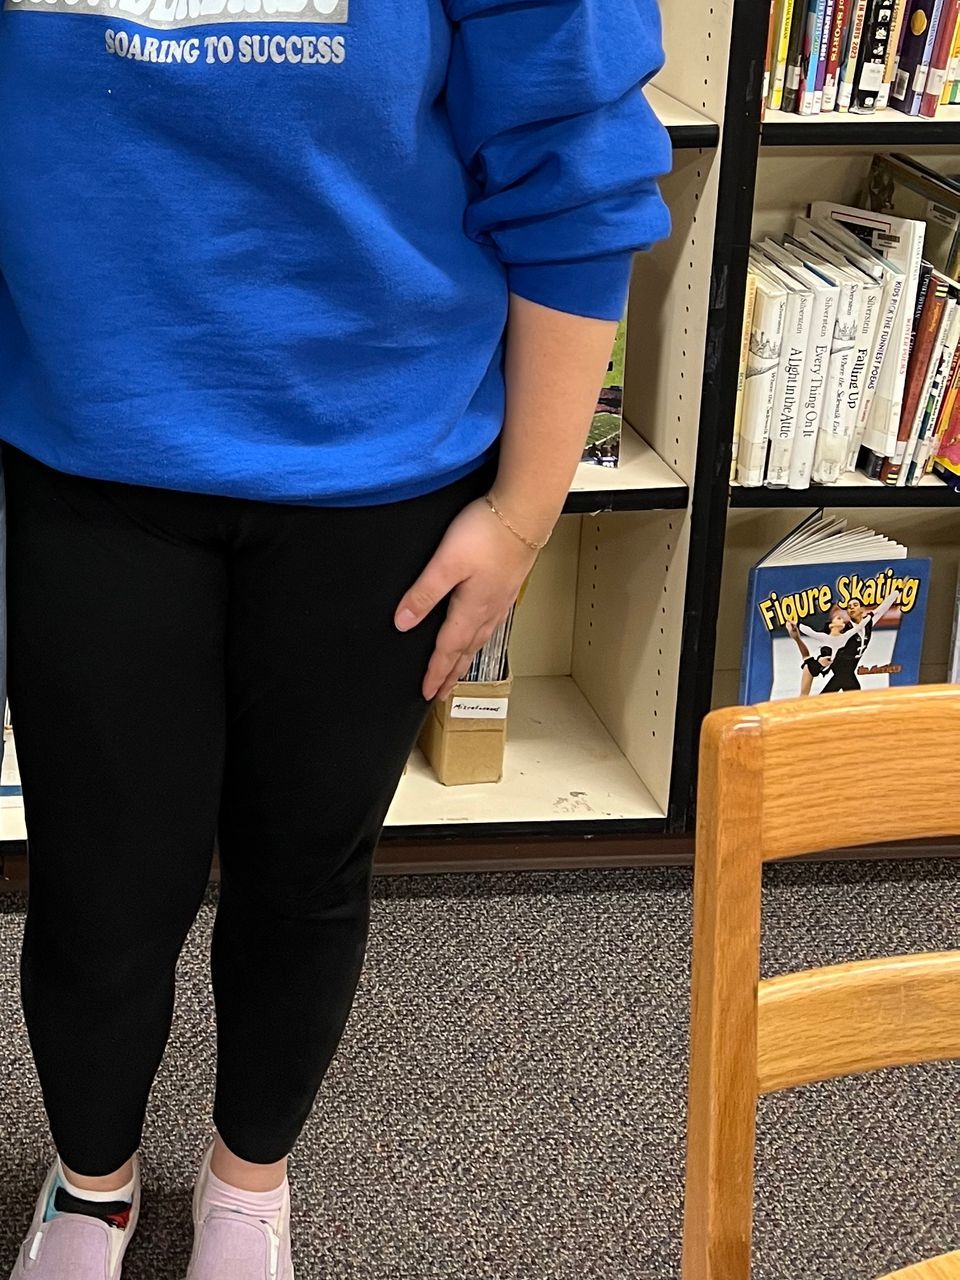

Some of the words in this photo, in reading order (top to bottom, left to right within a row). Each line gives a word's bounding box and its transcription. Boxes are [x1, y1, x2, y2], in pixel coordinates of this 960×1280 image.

[857, 3, 866, 12] IN
[829, 10, 845, 63] SPORTS
[852, 13, 864, 40] SPORTS
[104, 29, 200, 64] SOARING
[204, 36, 234, 63] TO
[239, 35, 346, 65] SUCCESS
[848, 40, 859, 60] 2023
[845, 283, 858, 316] Silverstein
[890, 279, 905, 301] KIDS
[795, 294, 808, 334] Silverstein
[820, 296, 834, 336] Silverstein
[862, 295, 876, 335] Silverstein
[885, 299, 899, 316] PICK
[882, 314, 895, 330] THE
[808, 343, 828, 375] Every
[872, 328, 891, 365] FUNNIEST
[782, 356, 802, 385] Light
[837, 353, 850, 377] Where
[846, 346, 869, 390] Falling
[865, 364, 882, 391] POEMS
[803, 373, 824, 410] Thing
[836, 376, 847, 389] the
[831, 388, 845, 420] Sidewalk
[844, 389, 861, 410] Up
[776, 412, 794, 439] Attic
[802, 409, 818, 429] On
[800, 428, 815, 439] It
[758, 583, 833, 631] Figure
[837, 567, 921, 613] Skating
